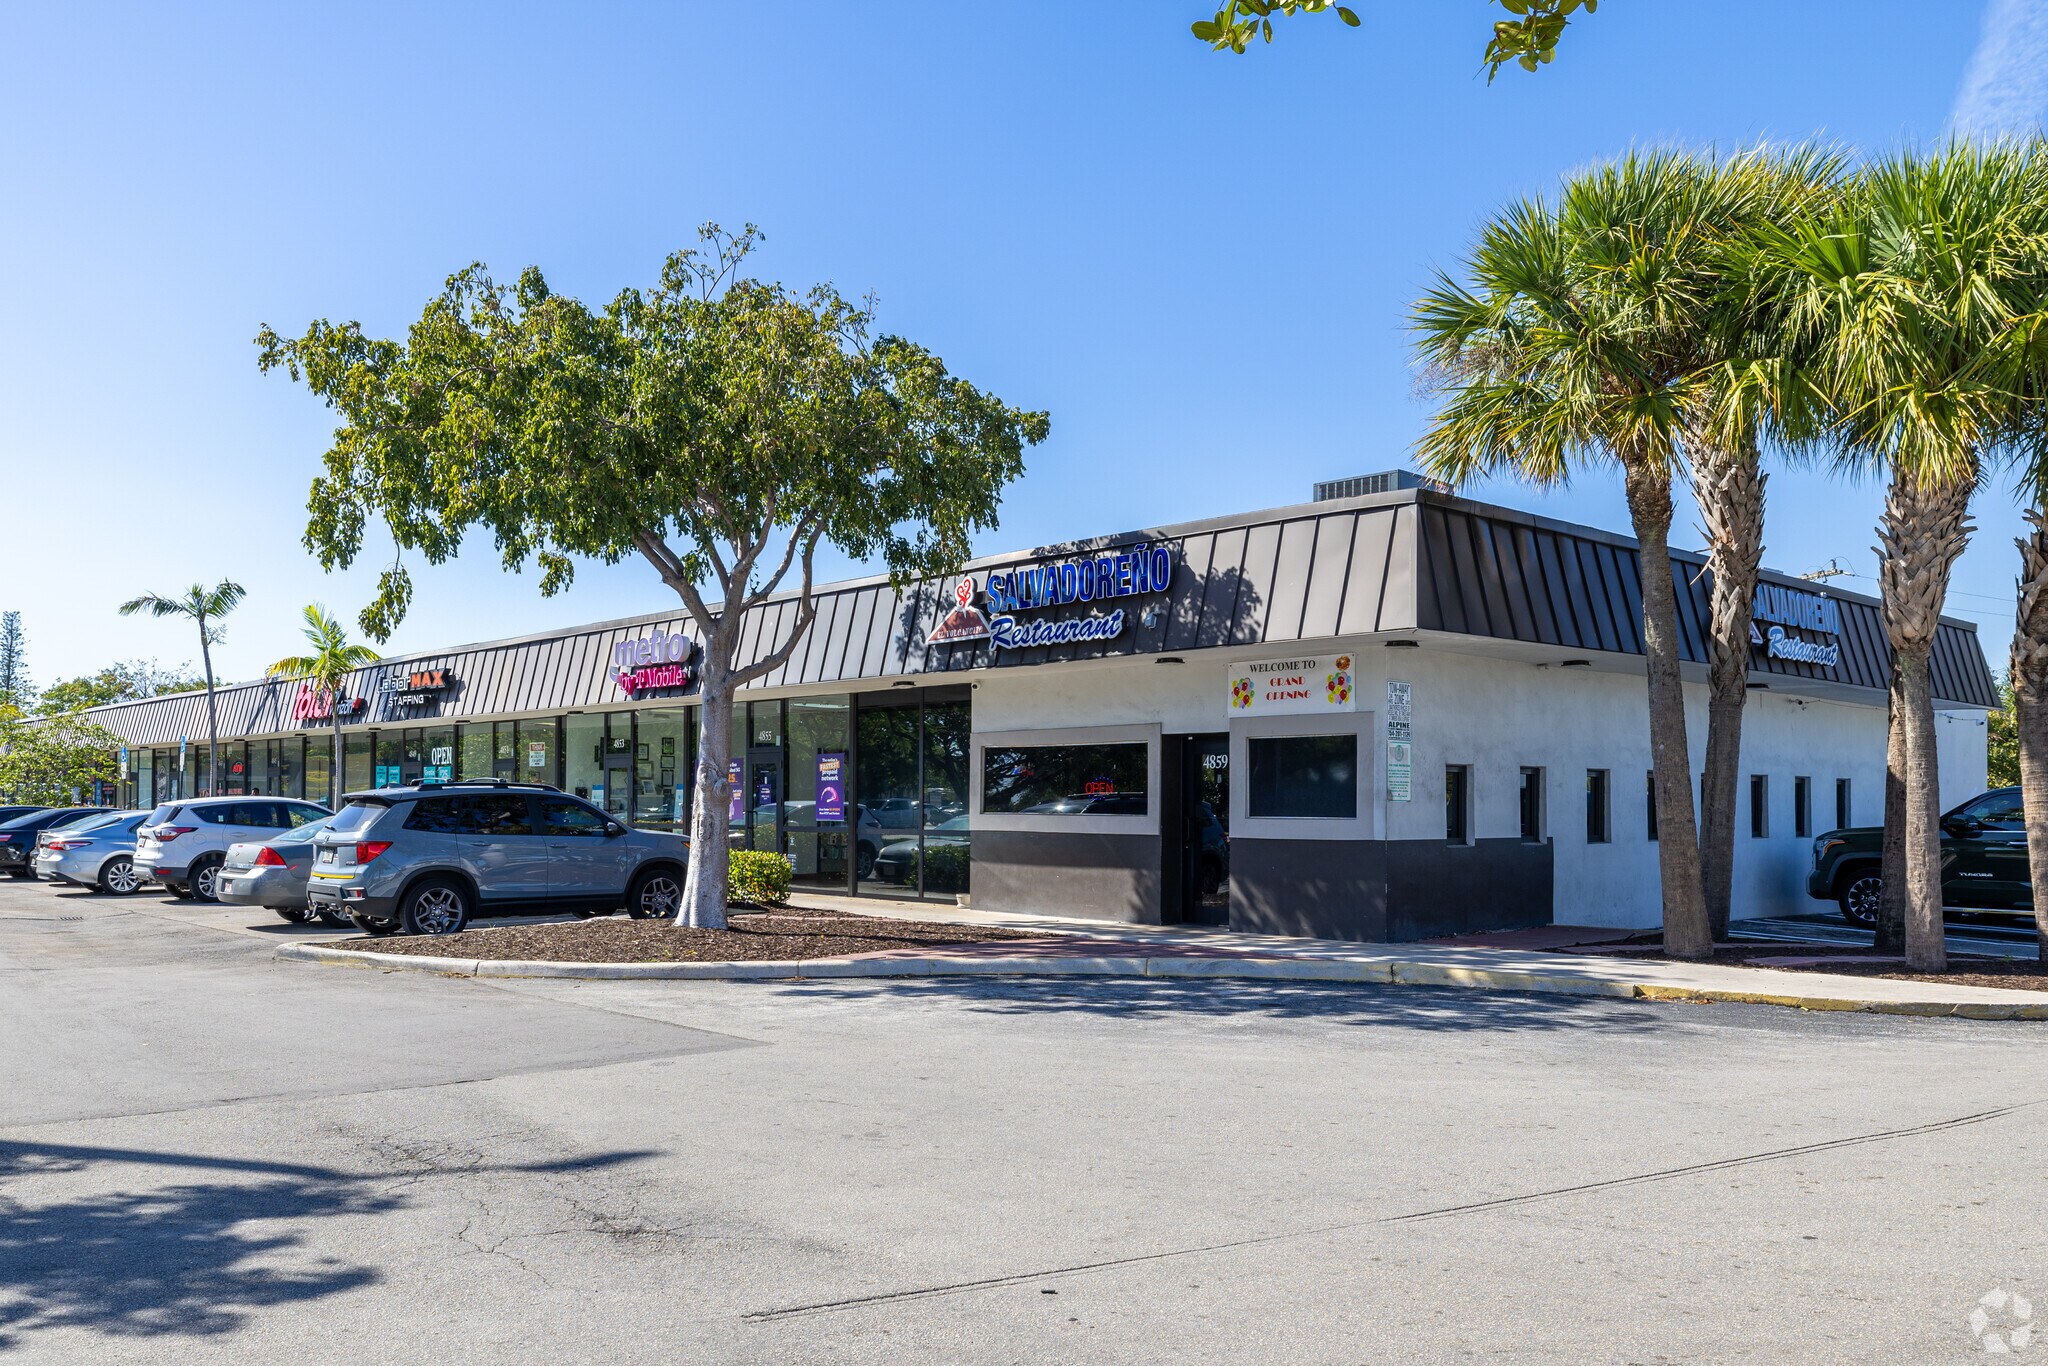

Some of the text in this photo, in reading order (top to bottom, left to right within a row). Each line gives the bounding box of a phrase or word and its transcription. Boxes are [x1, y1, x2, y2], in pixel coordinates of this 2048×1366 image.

[987, 543, 1171, 614] SALVADOREÑO
[989, 608, 1125, 651] Restaurant
[614, 630, 686, 667] metro
[1767, 625, 1838, 667] Restaurant
[1249, 660, 1316, 673] WELCOME TO
[621, 672, 634, 696] by
[1270, 676, 1305, 688] GRAND
[387, 694, 425, 707] STAFFING
[1265, 689, 1311, 701] OPENING
[1388, 721, 1410, 729] ALPINE
[758, 730, 772, 741] 4855
[431, 746, 453, 765] OPEN
[1203, 754, 1229, 769] 4859
[1085, 782, 1114, 795] OPEN
